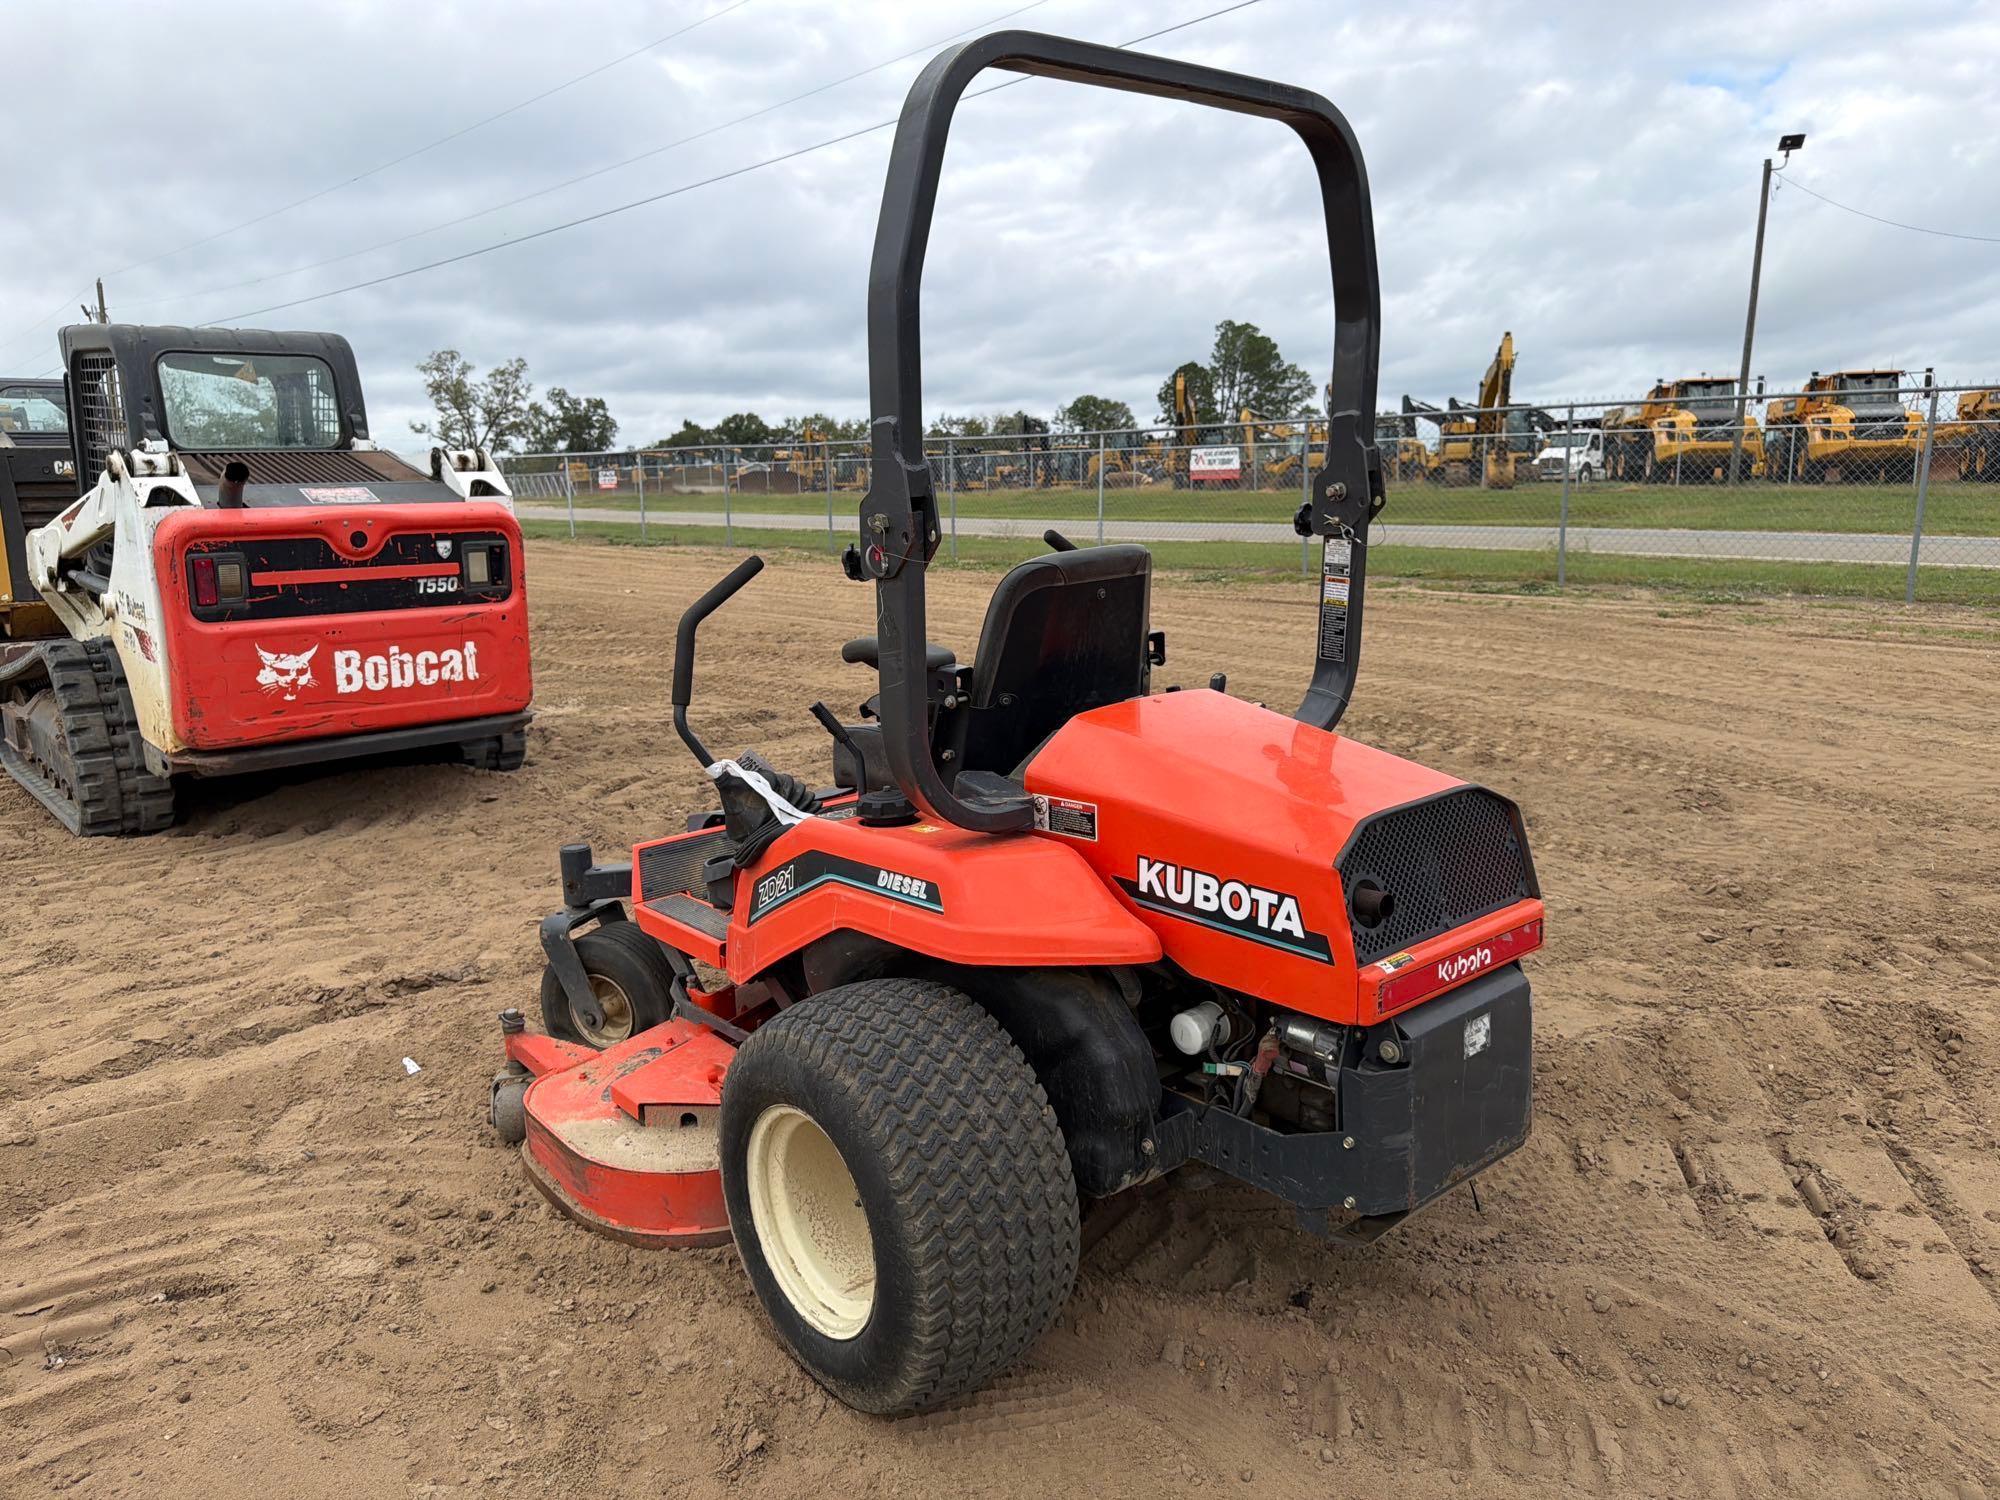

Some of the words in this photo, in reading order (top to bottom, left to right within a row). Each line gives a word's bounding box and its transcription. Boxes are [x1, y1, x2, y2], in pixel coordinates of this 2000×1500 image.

[417, 577, 458, 594] T550
[333, 641, 480, 694] Bobcat
[758, 864, 795, 908] ZD21
[877, 869, 928, 900] DIESEL
[1138, 857, 1305, 939] KUBOTA
[1438, 947, 1492, 982] Kubota
